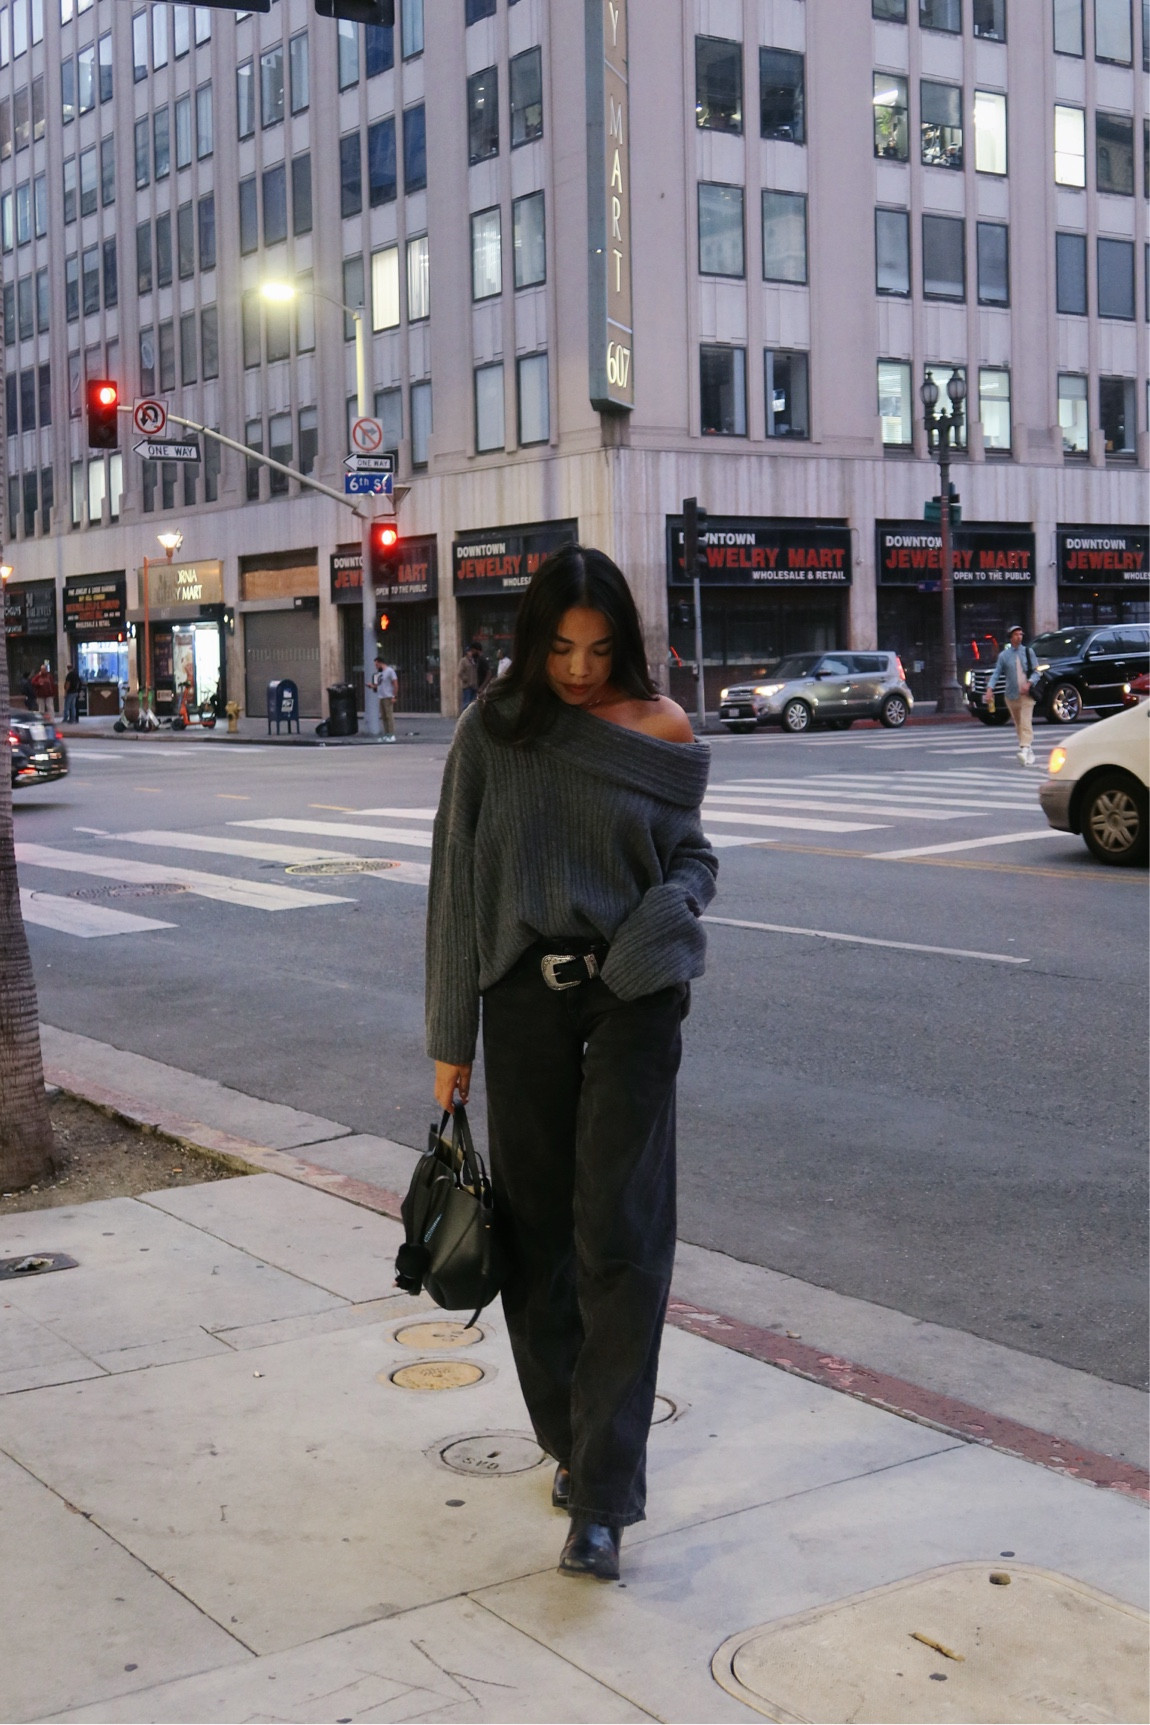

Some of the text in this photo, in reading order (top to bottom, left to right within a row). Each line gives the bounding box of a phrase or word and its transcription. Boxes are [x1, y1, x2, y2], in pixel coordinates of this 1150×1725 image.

[609, 94, 623, 293] MART
[606, 342, 631, 389] 607
[148, 445, 193, 457] ONE WAY
[349, 477, 370, 491] 6th
[885, 535, 943, 548] DOWNTOW
[1066, 538, 1126, 550] DOWNTOWN
[456, 542, 506, 558] DOWNTOWN
[678, 548, 846, 568] WELRY MART
[457, 554, 522, 580] JEWELRY
[979, 550, 1031, 569] MART
[1066, 551, 1145, 570] JEWELRY
[752, 570, 846, 580] WHOLESALE & RETAIL
[953, 571, 1031, 581] OPEN TO THE PUBLIC
[181, 584, 203, 601] MART
[375, 584, 428, 596] OPEN TO THE PUBLIC
